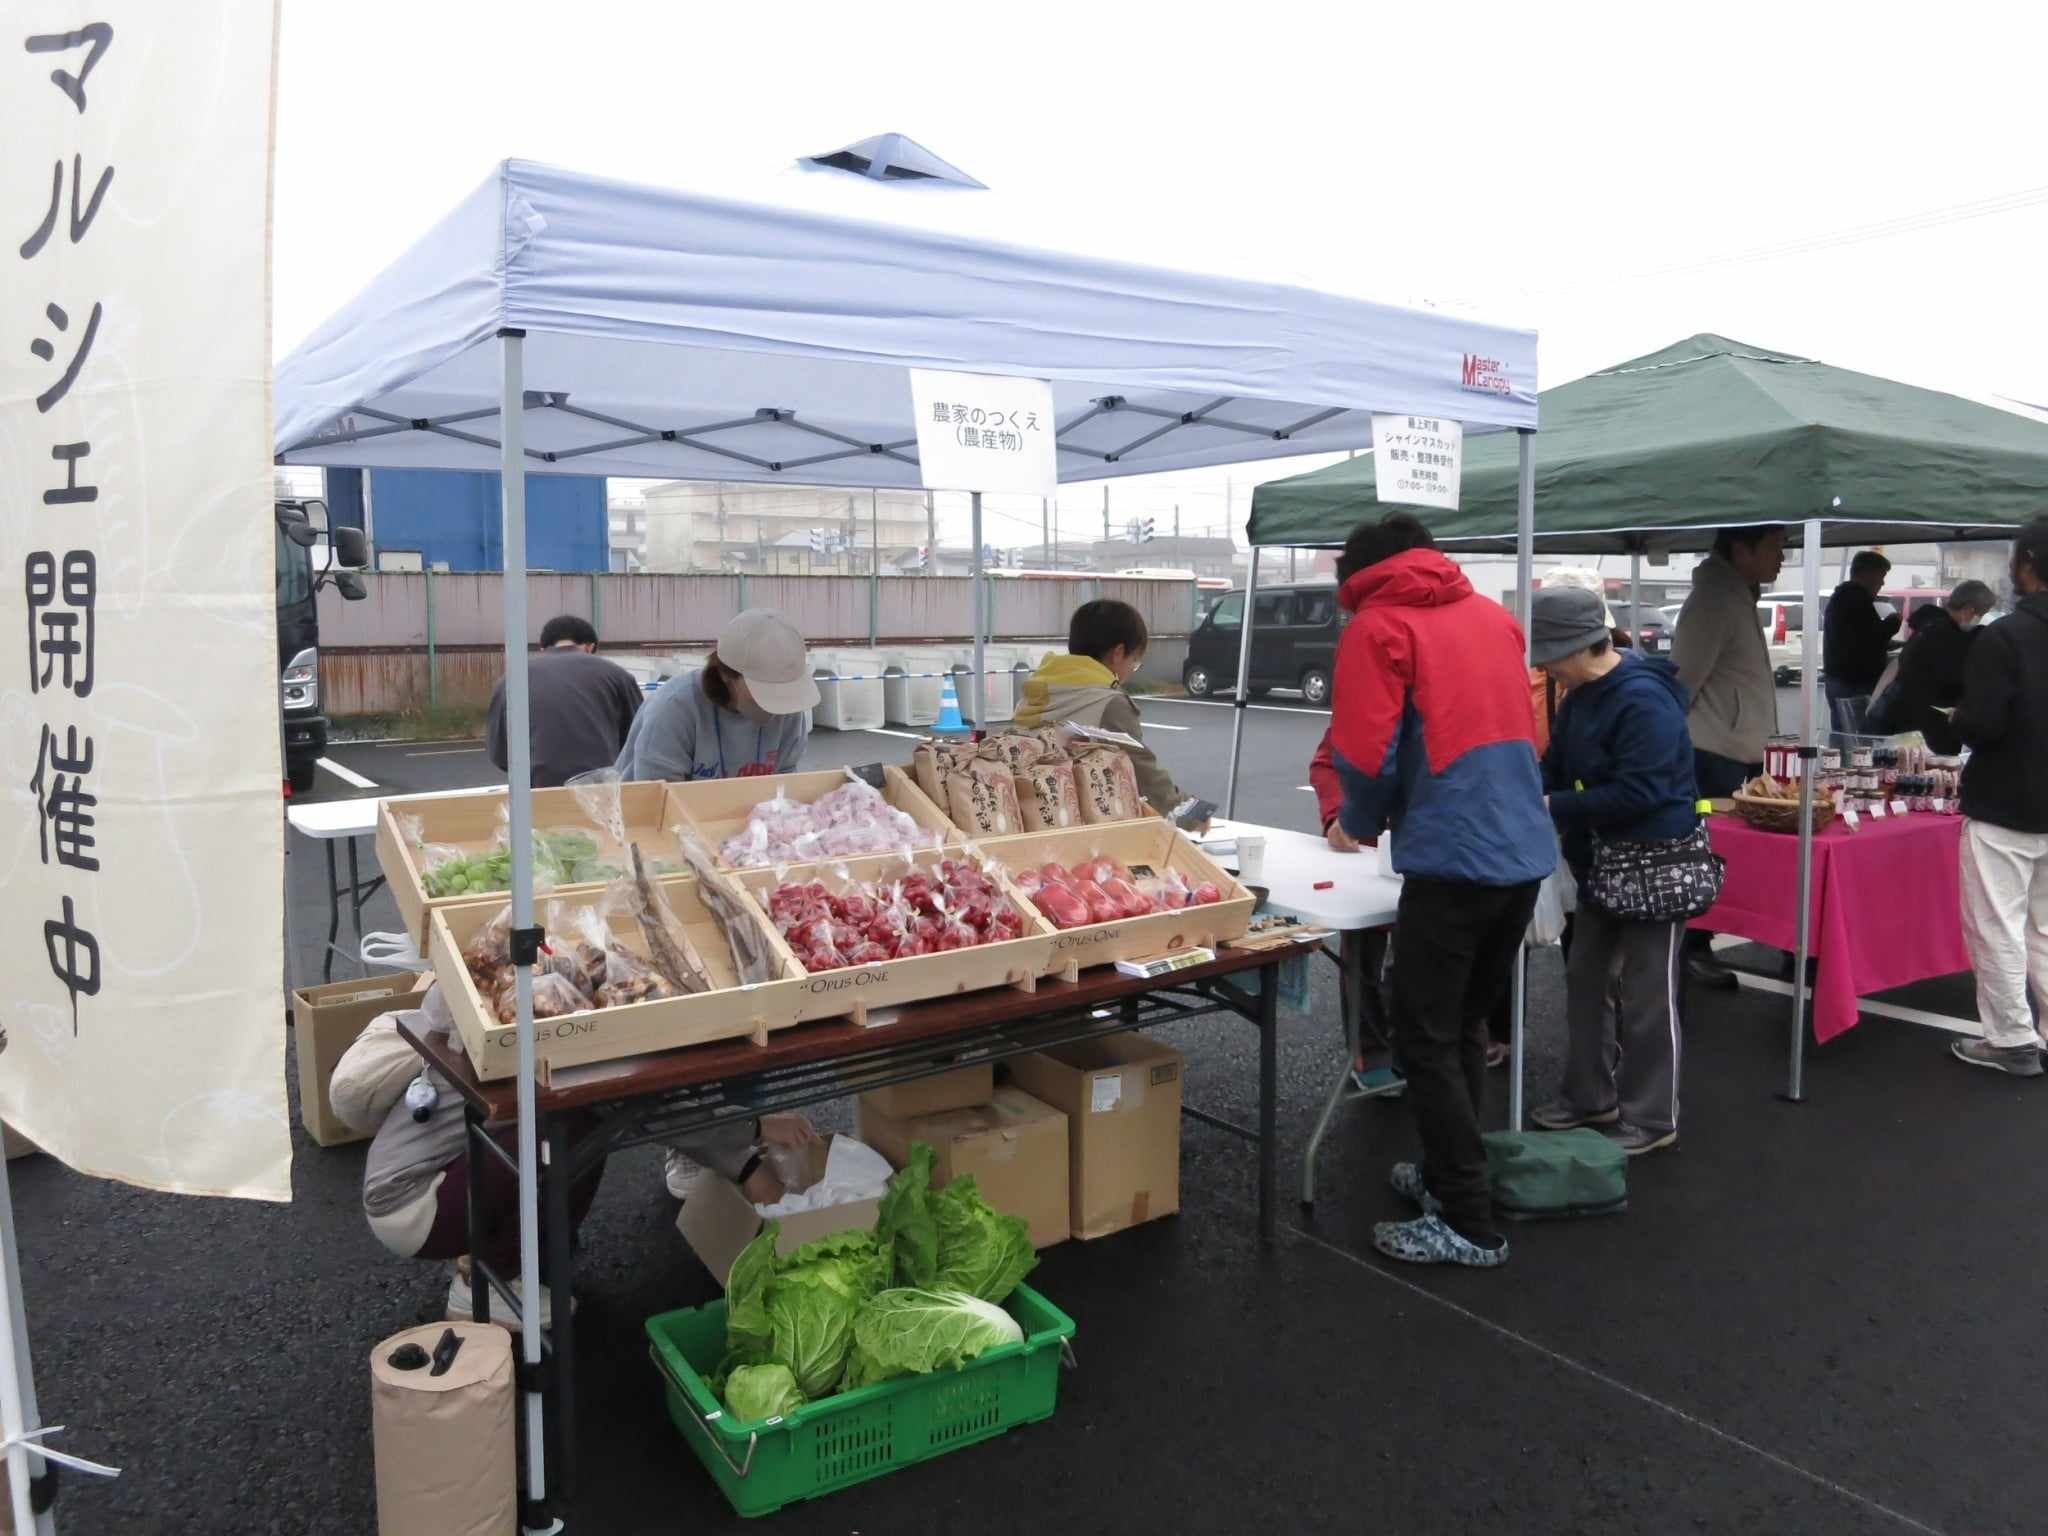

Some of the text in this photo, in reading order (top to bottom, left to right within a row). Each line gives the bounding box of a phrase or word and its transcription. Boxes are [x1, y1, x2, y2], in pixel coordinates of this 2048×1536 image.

[933, 401, 1041, 431] 農家のつくえ
[956, 426, 1023, 452] (農産物)
[1384, 432, 1456, 450] シャインマスカット
[20, 22, 114, 1037] マルシェ開催中
[811, 970, 889, 993] OPUS ONE
[556, 1020, 600, 1038] ONE
